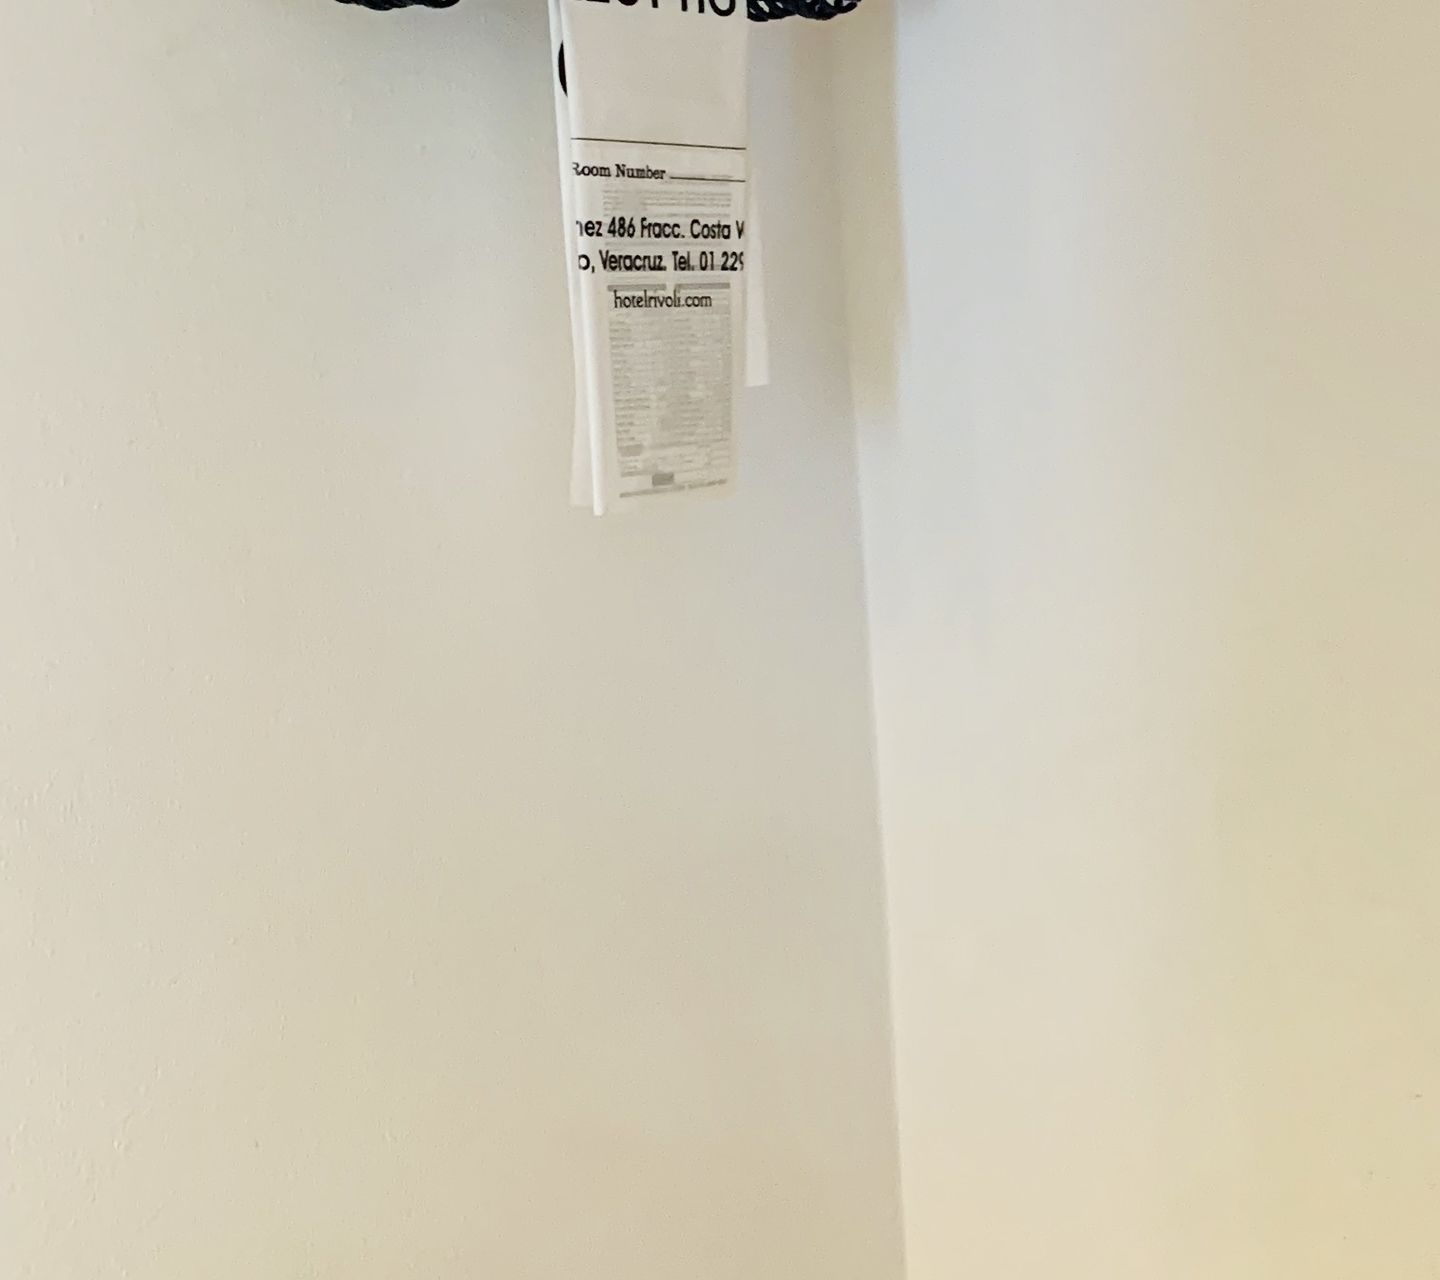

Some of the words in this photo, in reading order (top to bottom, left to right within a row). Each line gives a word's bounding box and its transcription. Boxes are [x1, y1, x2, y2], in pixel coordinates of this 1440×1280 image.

[615, 163, 666, 180] Number
[607, 217, 636, 238] 486
[640, 217, 685, 239] Fracc.
[690, 220, 731, 239] Costa
[599, 250, 667, 271] Veracruz.
[672, 251, 695, 271] Tel.
[699, 251, 714, 270] 01
